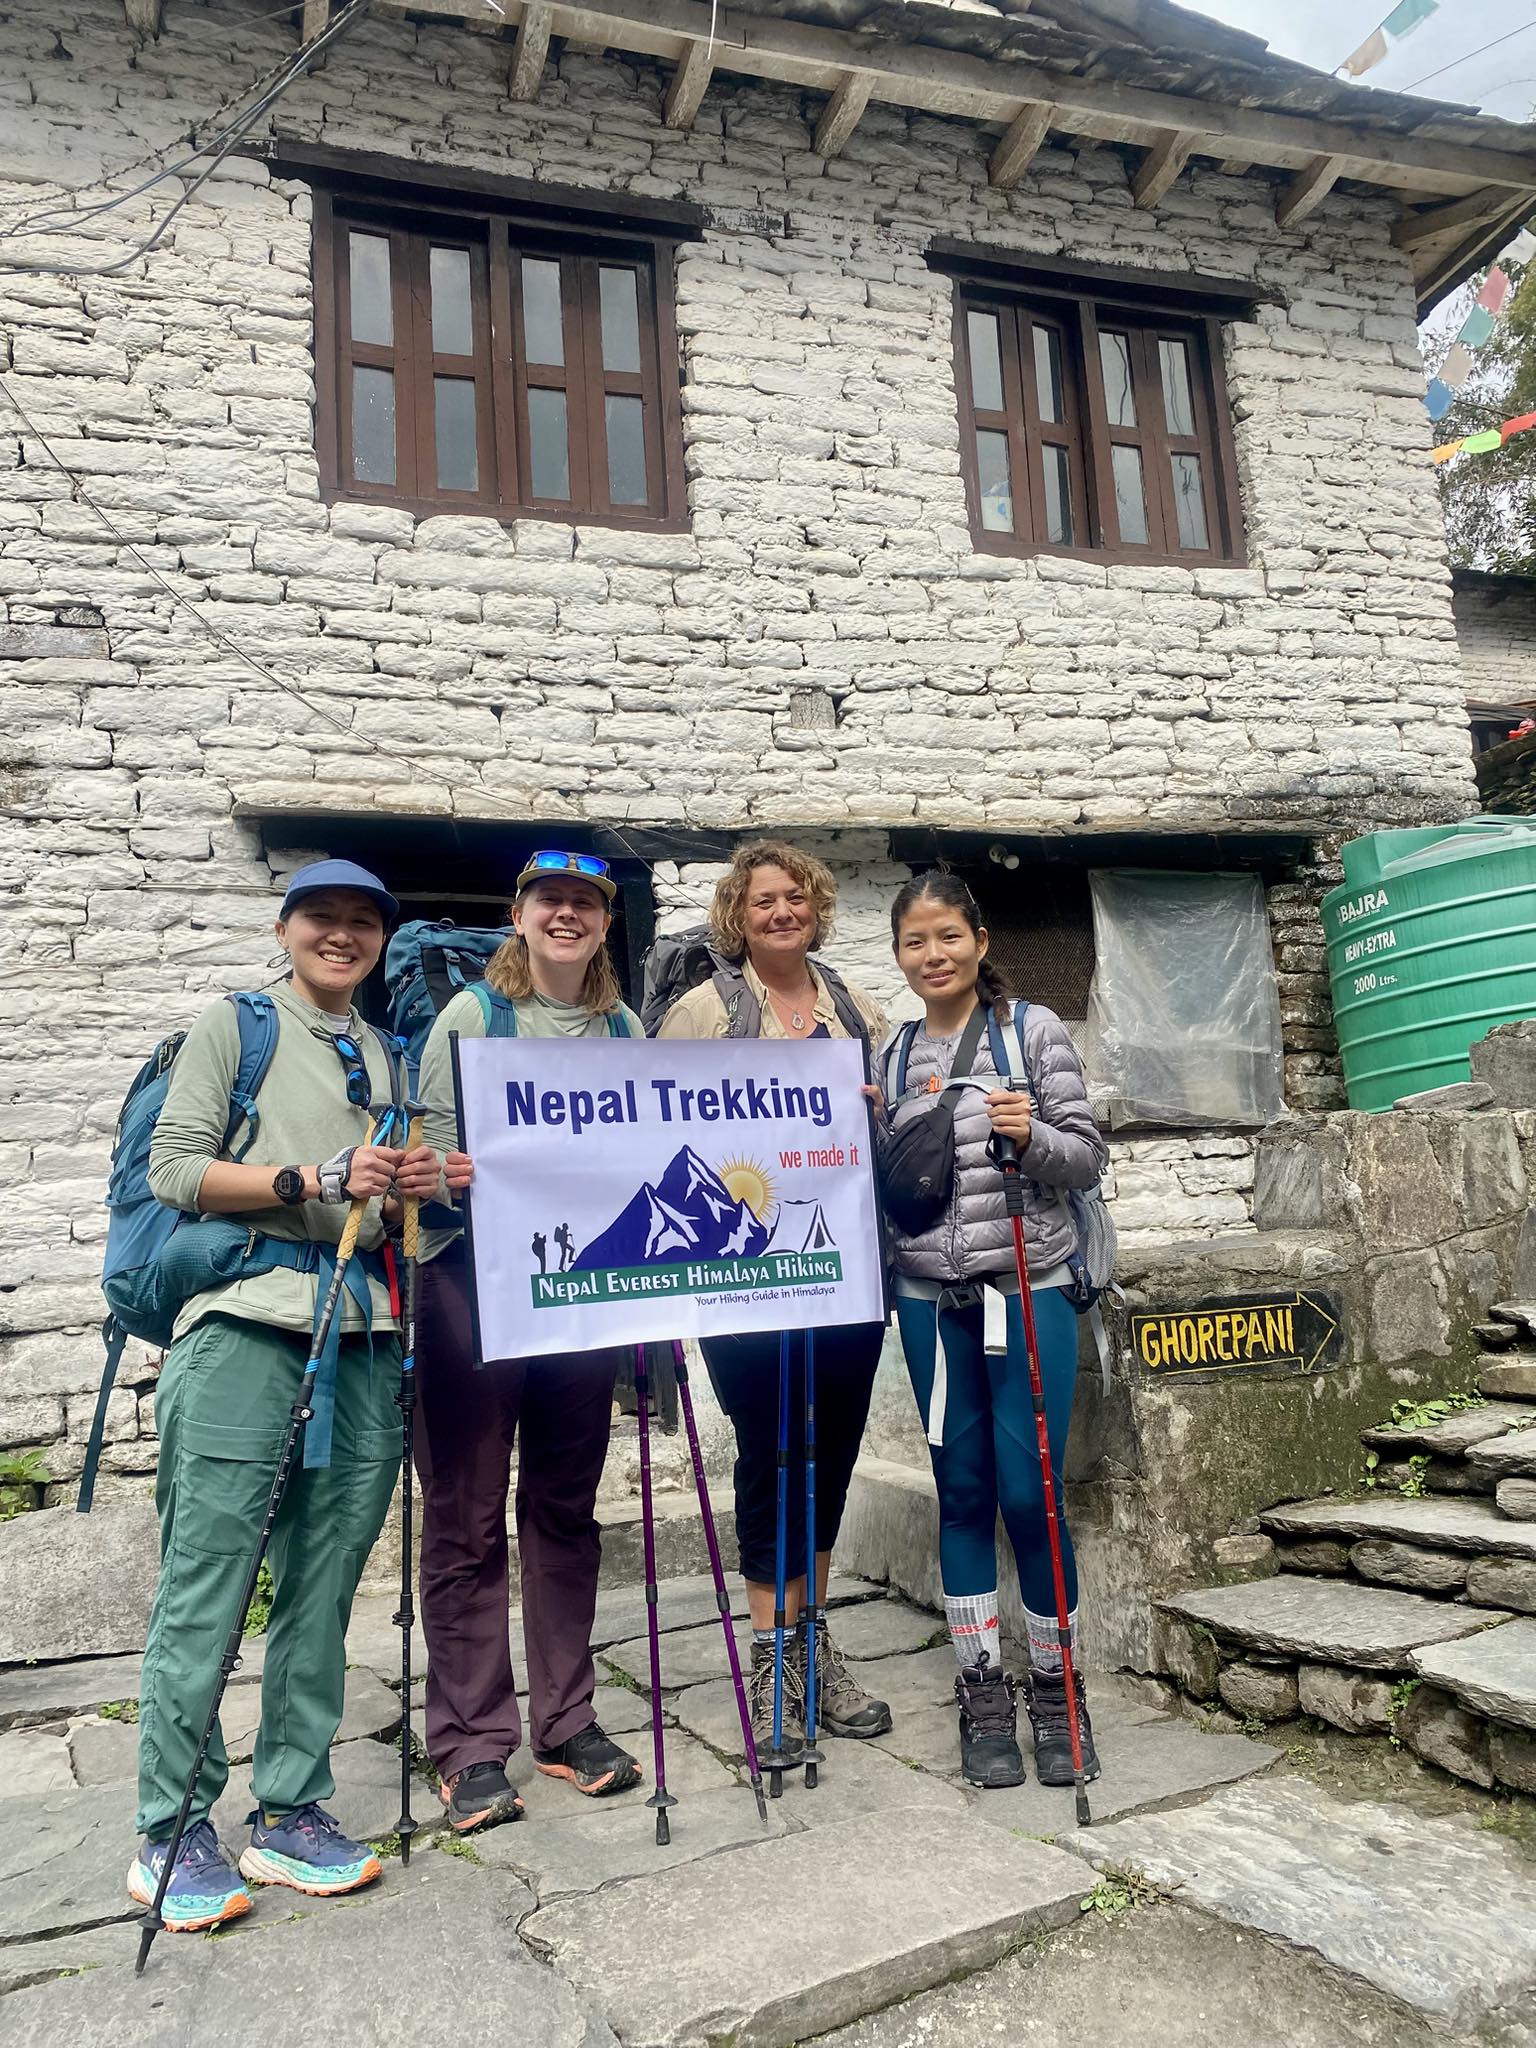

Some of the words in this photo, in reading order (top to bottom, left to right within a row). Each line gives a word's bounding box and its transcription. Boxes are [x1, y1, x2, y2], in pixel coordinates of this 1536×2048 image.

[1339, 889, 1389, 922] BAJRA
[1354, 973, 1376, 995] 2000
[1379, 975, 1398, 986] Ltrs.
[506, 1080, 638, 1135] Nepal
[651, 1078, 832, 1127] Trekking
[779, 1151, 802, 1168] we
[807, 1143, 844, 1167] made
[850, 1142, 859, 1165] it
[694, 1296, 717, 1306] Your
[719, 1293, 750, 1304] Hiking
[752, 1290, 779, 1301] Guide
[781, 1290, 791, 1298] in
[792, 1286, 836, 1297] Himalaya
[1141, 1308, 1295, 1368] GHOREPANI
